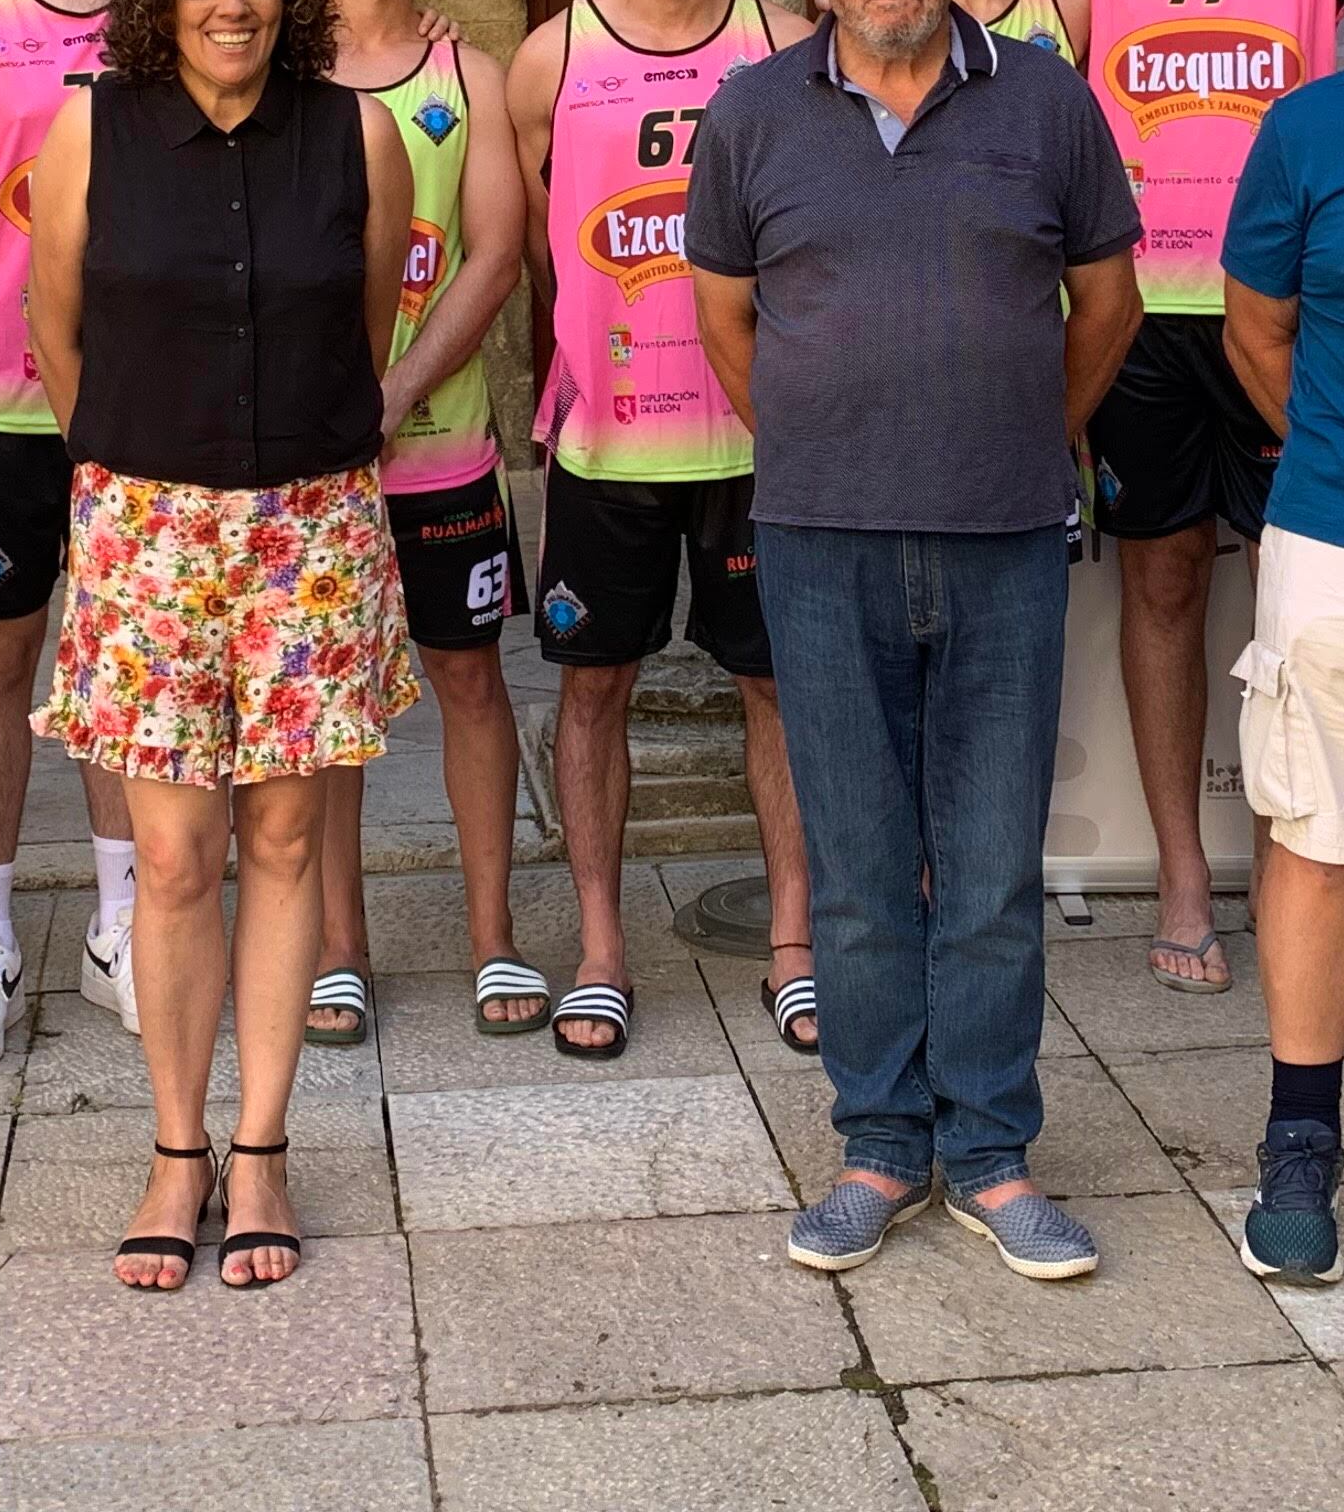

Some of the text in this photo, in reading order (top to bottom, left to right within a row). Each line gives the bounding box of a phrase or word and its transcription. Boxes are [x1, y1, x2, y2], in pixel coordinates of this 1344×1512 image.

[644, 69, 688, 82] emec
[1128, 42, 1285, 99] Ezequiel
[1138, 100, 1205, 126] EMBUTIDOS
[1207, 100, 1216, 110] Y
[638, 107, 706, 168] 67
[1146, 176, 1222, 185] Ayuntamiento
[1151, 229, 1213, 239] DIPUTACIÓN
[1151, 239, 1193, 249] DE LEÓN
[623, 261, 685, 290] EMBUTIDOS
[640, 390, 699, 403] DIPUTACIÓN
[641, 403, 681, 413] DE LEÓN
[422, 512, 492, 539] RUALMAR
[467, 551, 508, 610] 63
